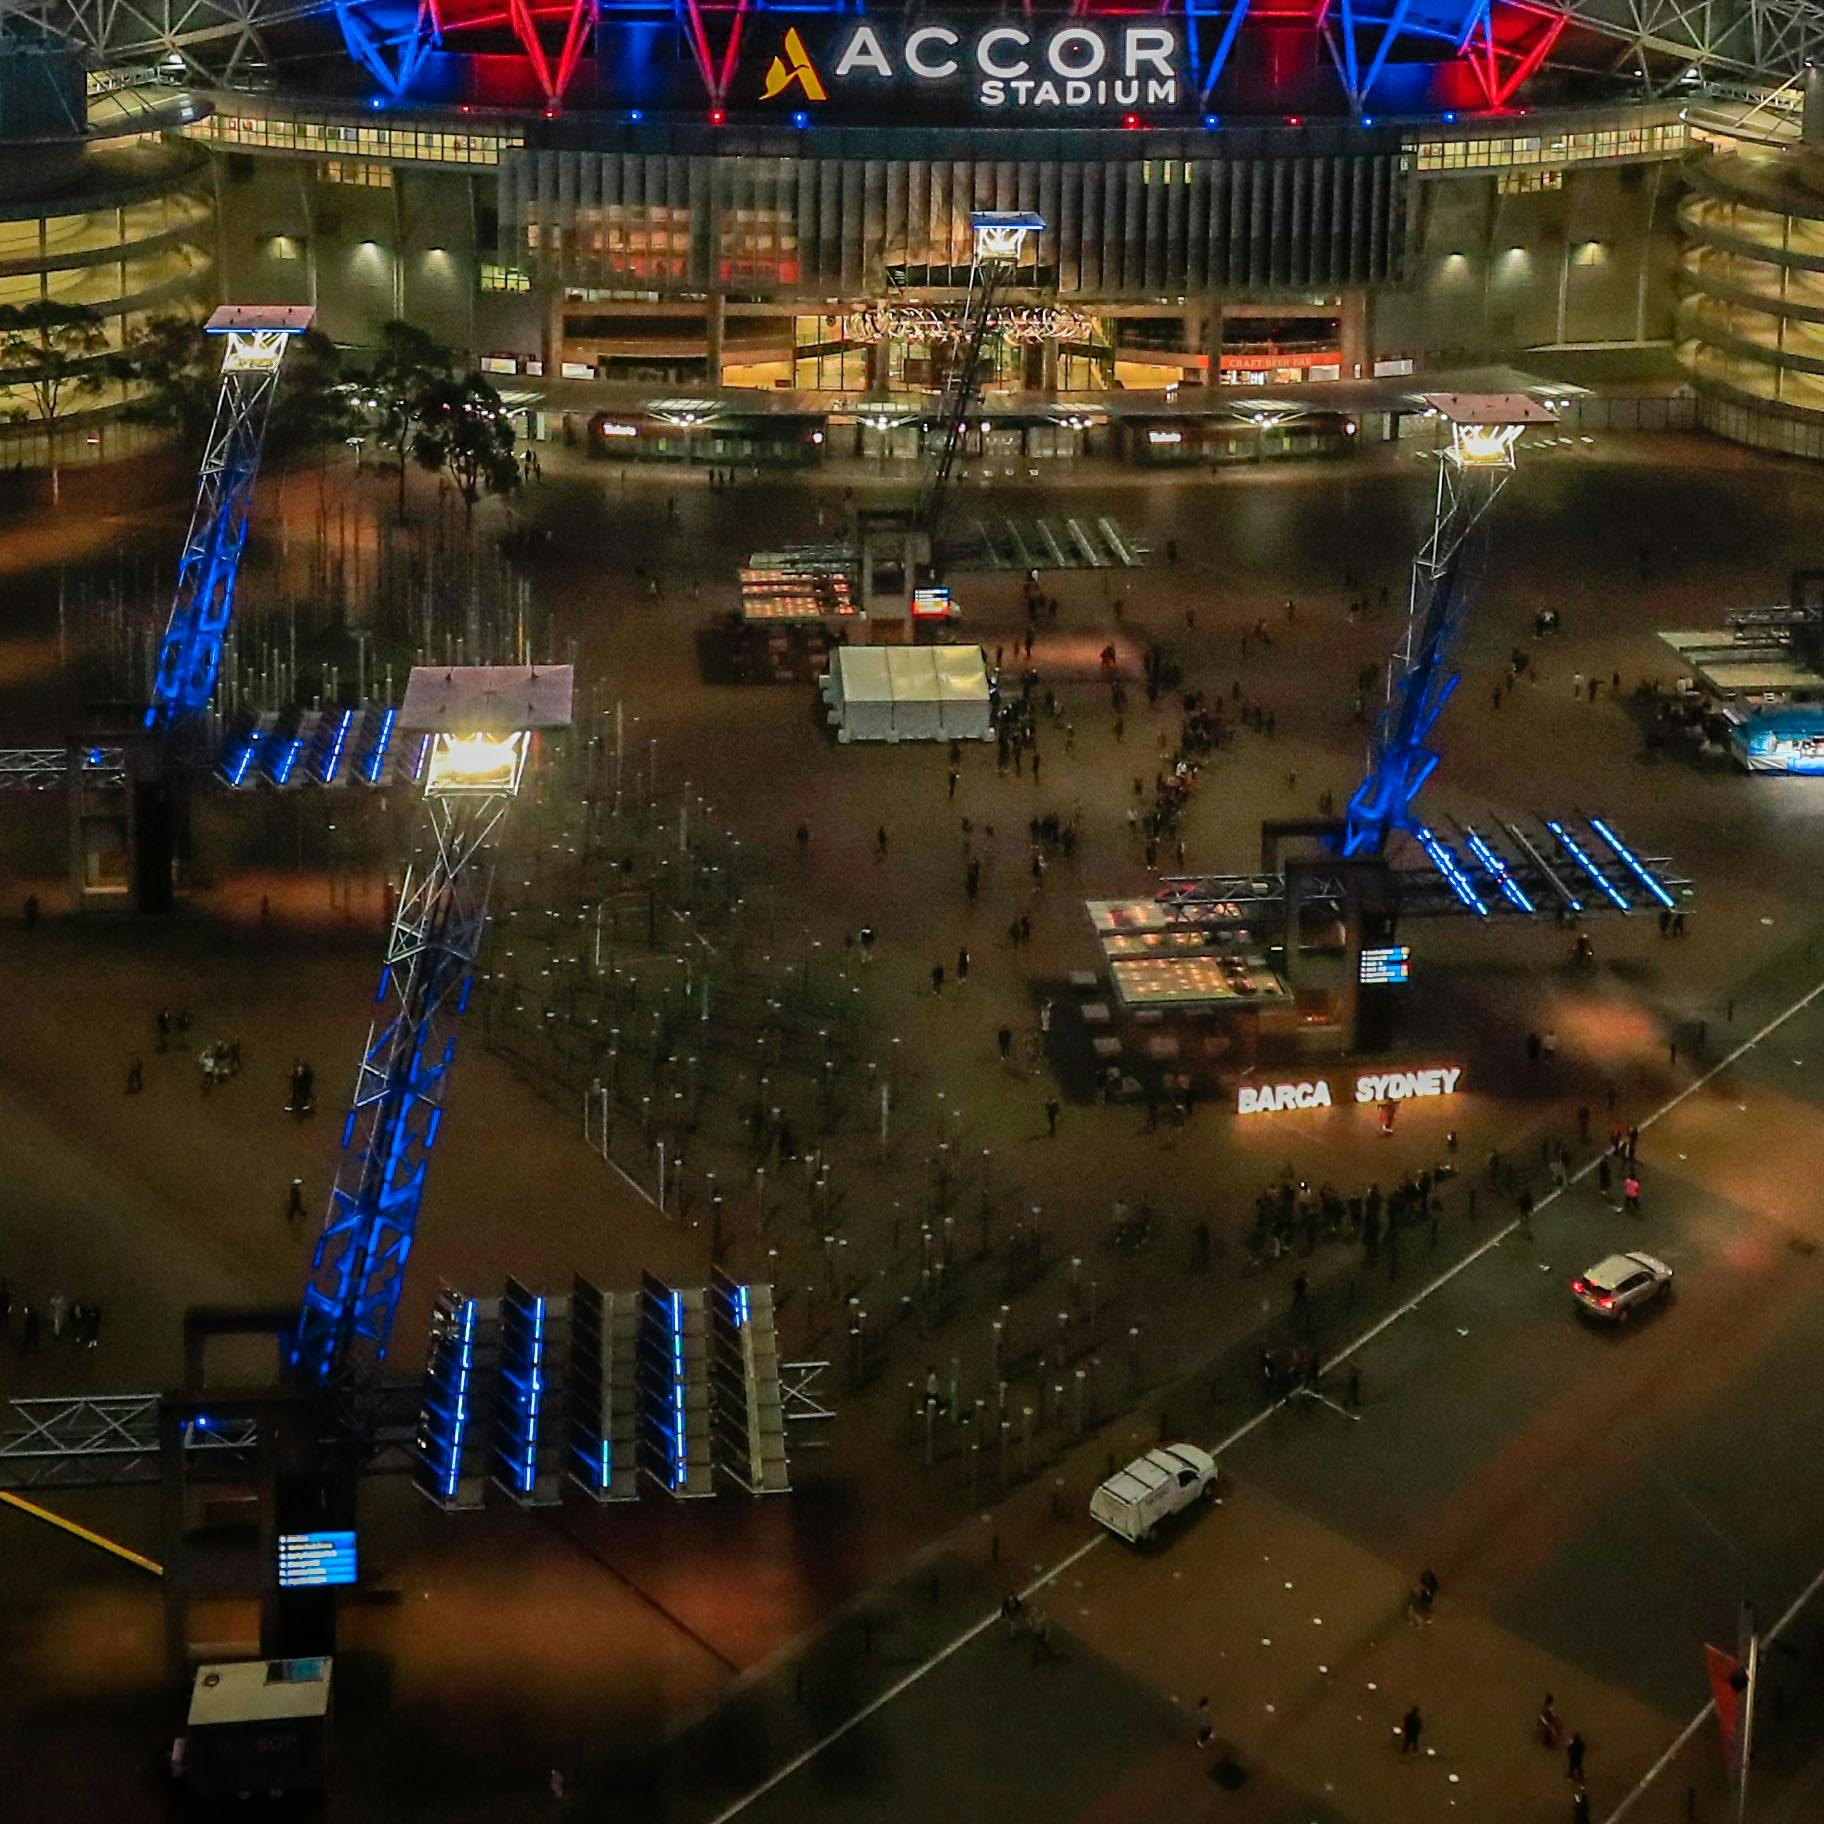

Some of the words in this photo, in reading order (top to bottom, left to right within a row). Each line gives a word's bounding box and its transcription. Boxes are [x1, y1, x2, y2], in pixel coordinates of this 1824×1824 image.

[835, 26, 1176, 78] ACCOR
[979, 79, 1176, 106] STADIUM
[1355, 1067, 1462, 1103] SYDNEY
